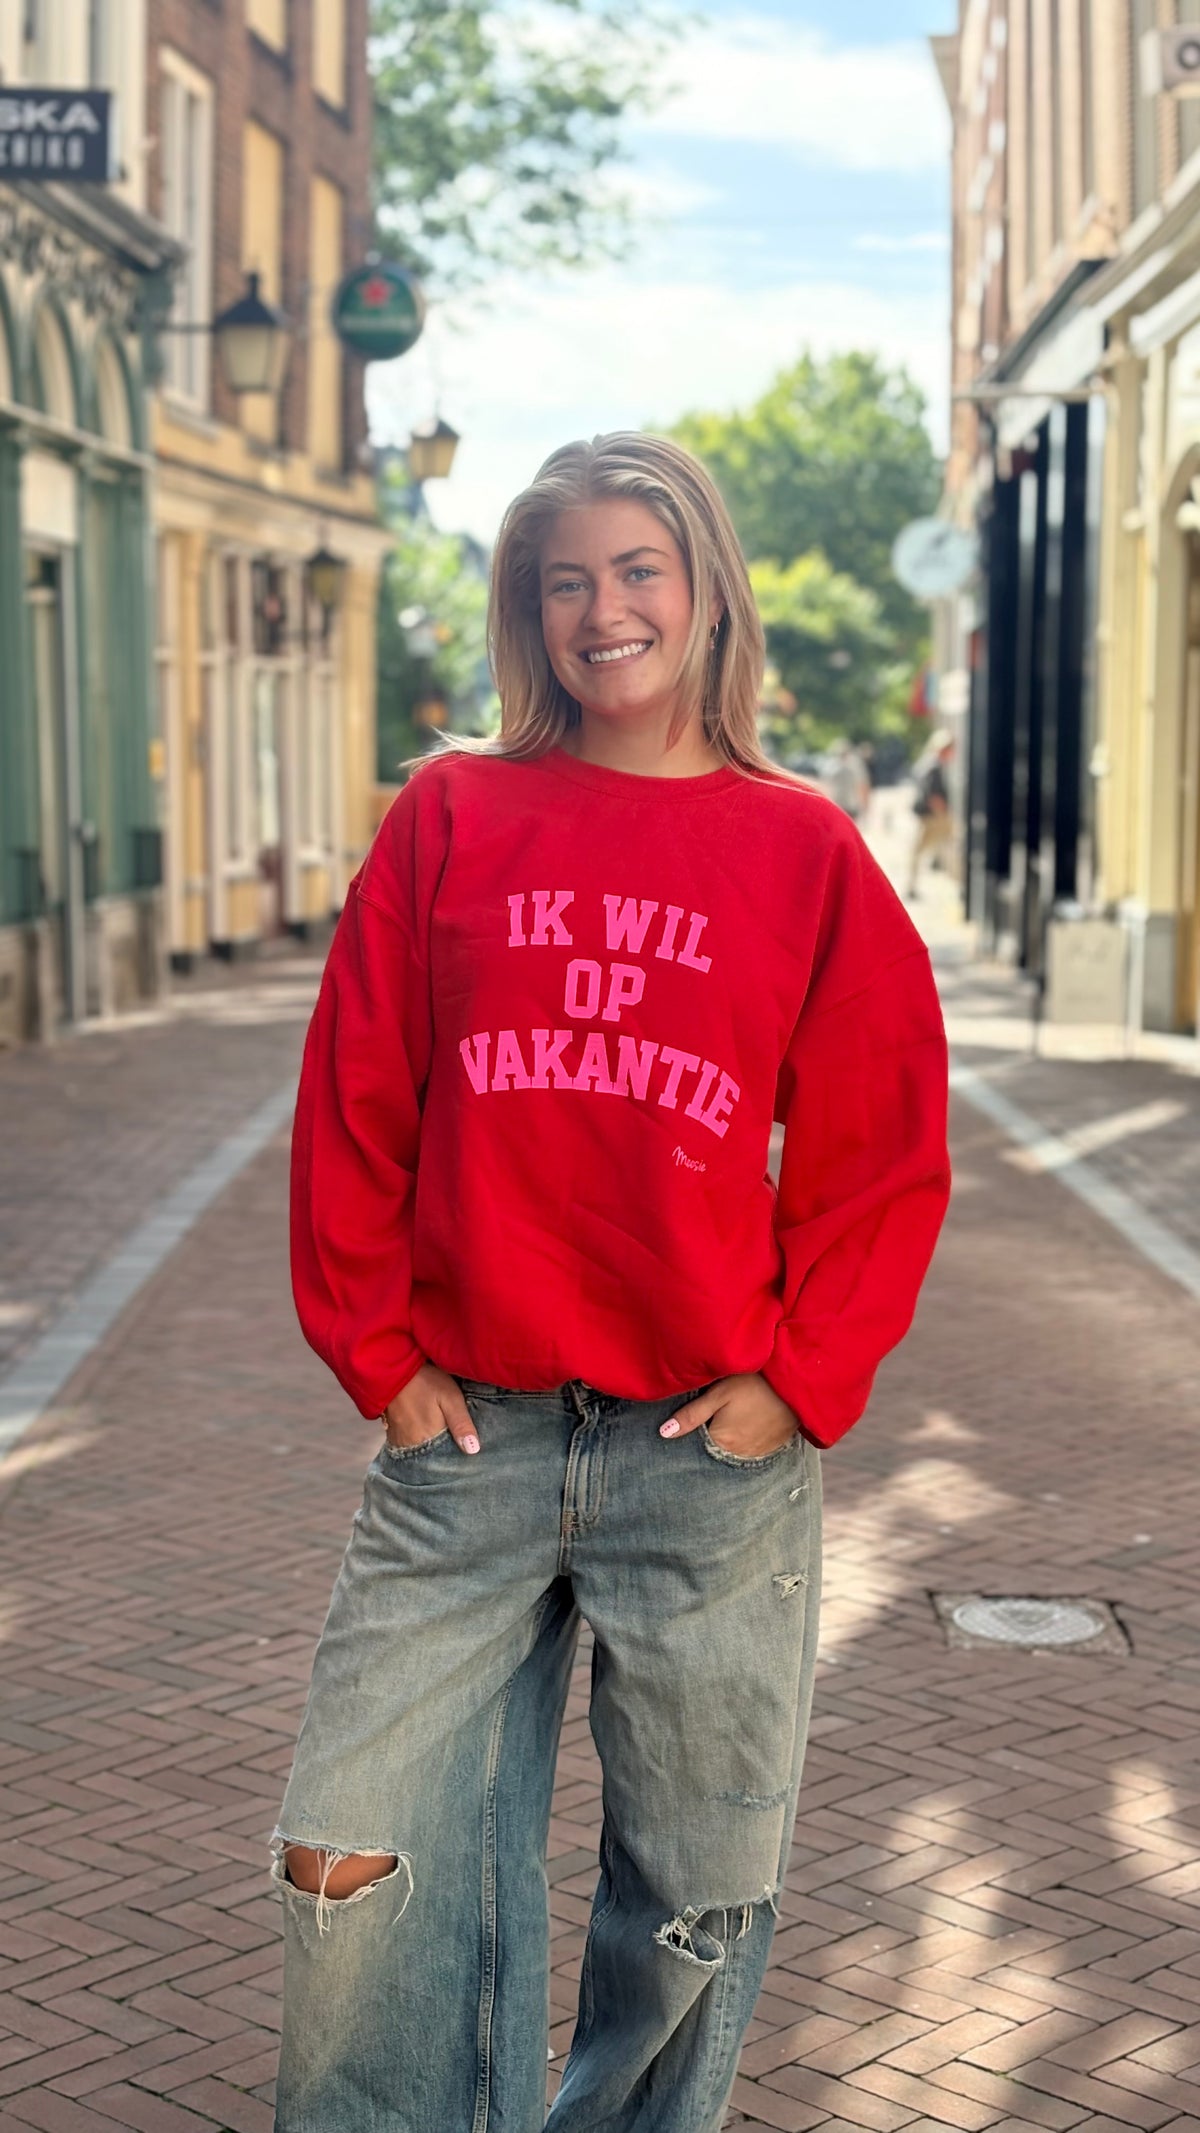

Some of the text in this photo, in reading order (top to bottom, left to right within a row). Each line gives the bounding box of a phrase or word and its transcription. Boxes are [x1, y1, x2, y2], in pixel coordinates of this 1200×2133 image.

[507, 890, 712, 974] IK WIL
[564, 958, 646, 1022] OP
[459, 1028, 741, 1139] VAKANTIE
